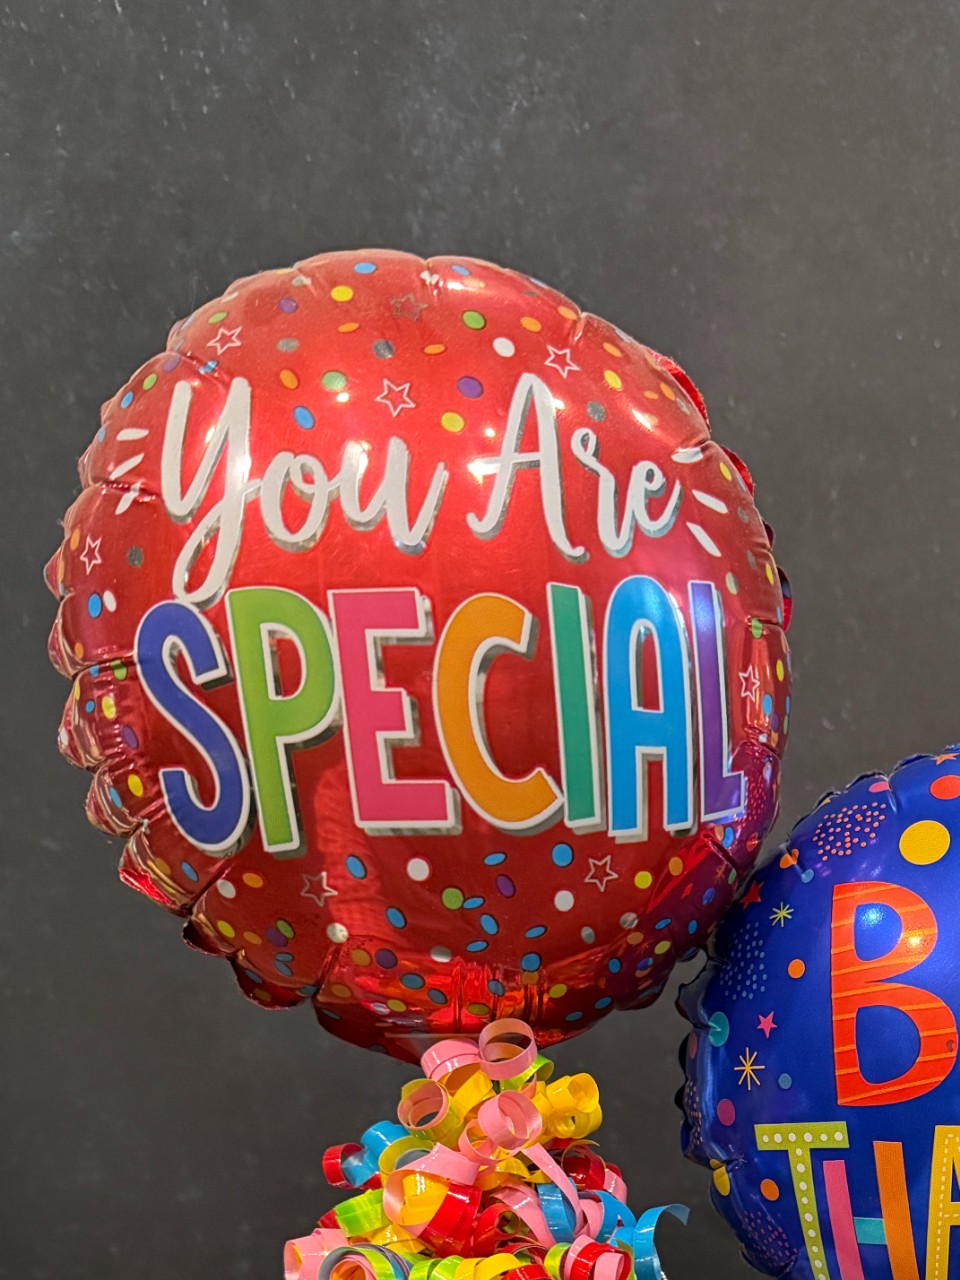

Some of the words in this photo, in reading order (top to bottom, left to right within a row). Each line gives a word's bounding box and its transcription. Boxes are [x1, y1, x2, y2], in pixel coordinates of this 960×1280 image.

[160, 376, 448, 604] You
[466, 372, 681, 560] Are
[134, 574, 748, 855] SPECIAL
